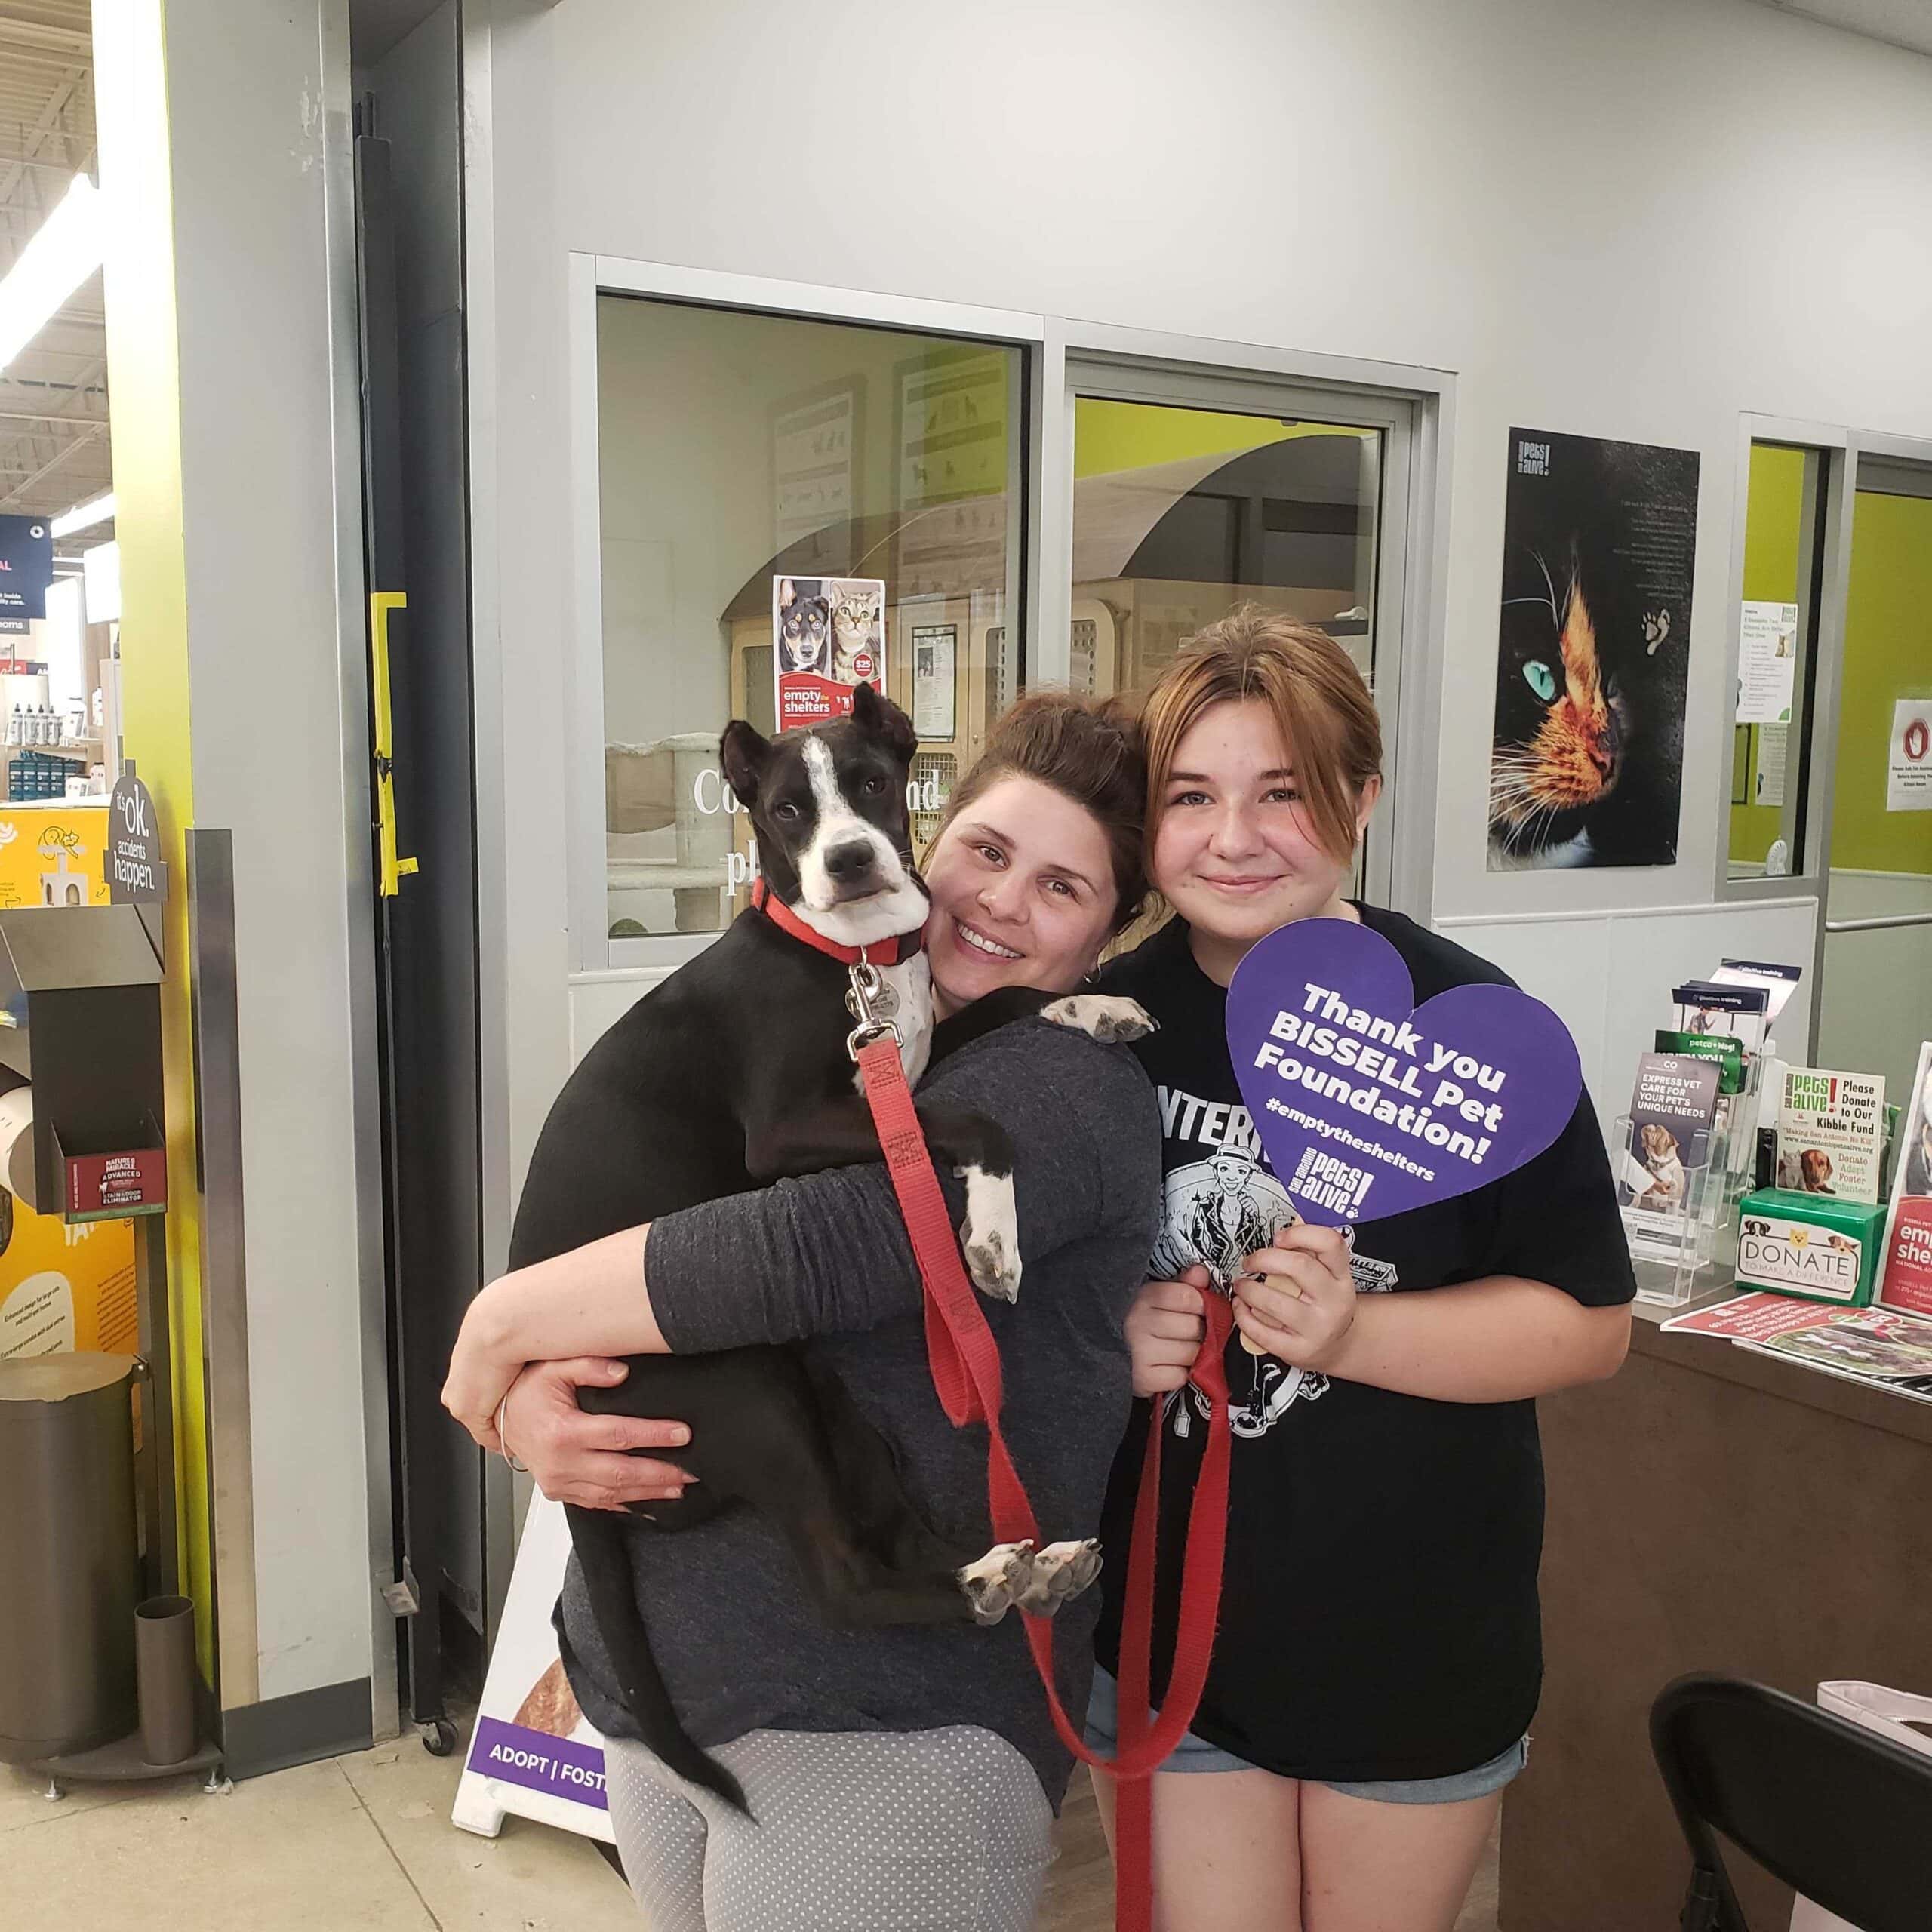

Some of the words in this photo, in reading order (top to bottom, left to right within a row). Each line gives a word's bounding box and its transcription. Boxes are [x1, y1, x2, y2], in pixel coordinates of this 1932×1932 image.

[855, 660, 871, 669] $25
[784, 690, 821, 703] empty
[784, 701, 830, 712] shelters
[694, 768, 750, 815] Co
[116, 791, 125, 811] it's
[125, 783, 149, 838] ok.
[118, 838, 146, 860] accidents
[114, 849, 155, 893] happen.
[725, 840, 761, 897] pl
[1302, 983, 1424, 1057] Thank
[1423, 1042, 1506, 1094] you
[1269, 1010, 1423, 1098] BISSELL
[1431, 1078, 1504, 1133] Pet
[1640, 1082, 1666, 1094] CARE
[1666, 1087, 1687, 1097] FOR
[1642, 1073, 1683, 1087] EXPRESS
[1684, 1079, 1703, 1090] VET
[1843, 1080, 1875, 1094] Please
[1253, 1041, 1492, 1165] Foundation!
[1638, 1091, 1665, 1103] YOUR
[1841, 1094, 1876, 1108] Donate
[1637, 1100, 1673, 1114] UNIQUE
[1674, 1106, 1706, 1118] NEEDS
[1841, 1107, 1850, 1118] to
[1854, 1107, 1872, 1120] Our
[1817, 1117, 1847, 1131] Kibble
[1851, 1122, 1875, 1135] Fund
[1265, 1097, 1435, 1183] #emptytheshelters
[1838, 1153, 1868, 1166] Donate
[102, 1171, 141, 1181] ADVANCED
[1838, 1173, 1866, 1185] Foster
[1832, 1182, 1872, 1196] Volunteer
[103, 1195, 142, 1204] ELIMINATOR
[1746, 1241, 1850, 1277] DONATE
[1897, 1242, 1932, 1265] she
[1745, 1261, 1757, 1270] TO
[1759, 1264, 1782, 1276] MAKE
[489, 1743, 550, 1774] ADOPT
[560, 1763, 608, 1792] FOST
